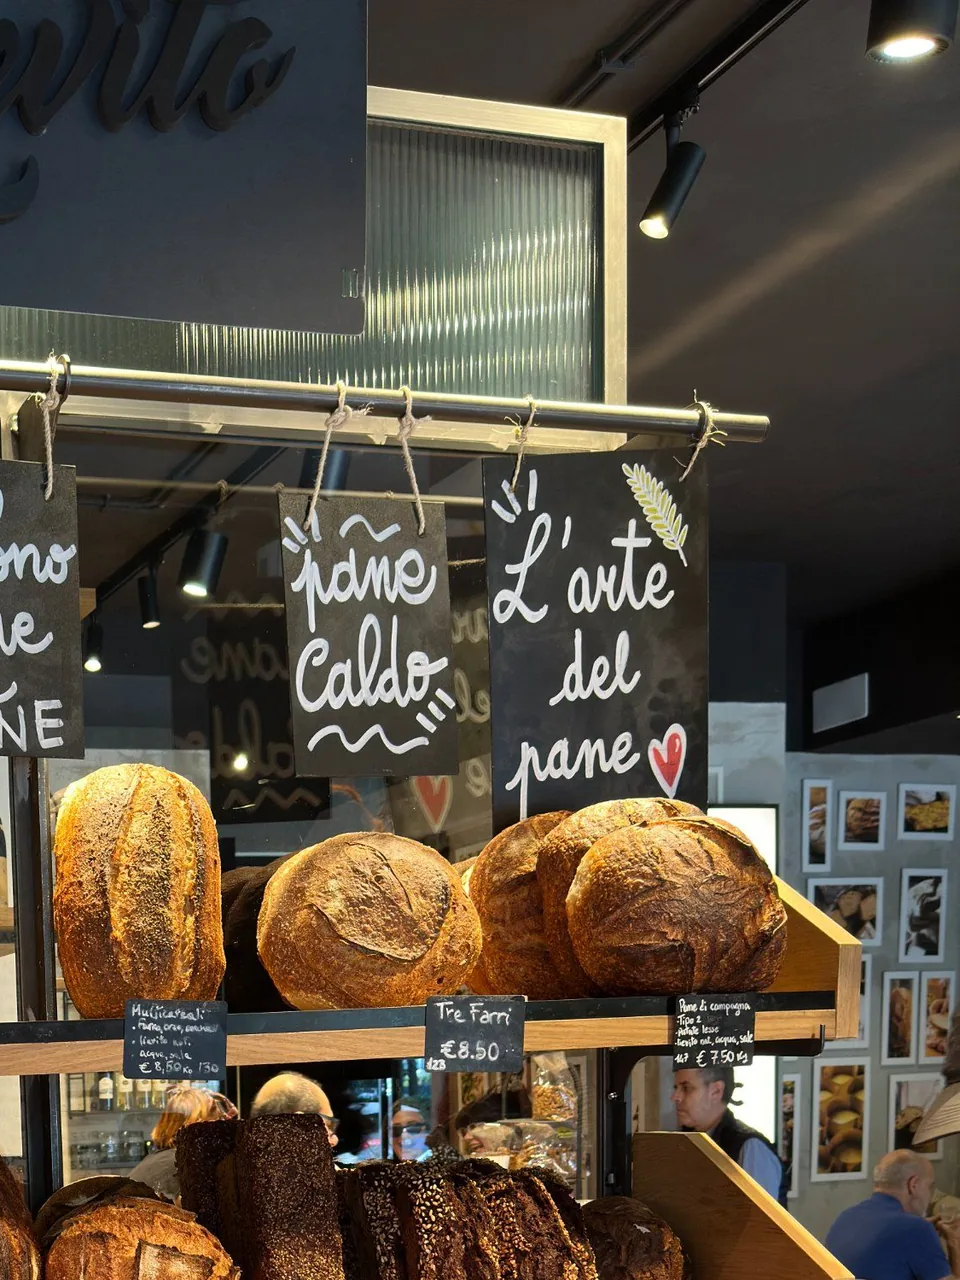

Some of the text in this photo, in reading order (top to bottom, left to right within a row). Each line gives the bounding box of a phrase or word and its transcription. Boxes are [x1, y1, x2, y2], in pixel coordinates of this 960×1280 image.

[290, 548, 438, 632] pane
[295, 613, 449, 714] Caldo
[549, 629, 642, 707] del
[506, 729, 642, 821] pane
[434, 1001, 512, 1026] Tre Farri
[679, 998, 751, 1016] Pane di campagna
[677, 1014, 694, 1027] Tipo
[702, 1025, 719, 1034] lesse
[740, 1031, 753, 1043] sale
[426, 1057, 446, 1070] 123
[696, 1050, 707, 1067] €
[710, 1050, 734, 1065] 7.50
[737, 1051, 748, 1063] Kg
[139, 1062, 152, 1073] €
